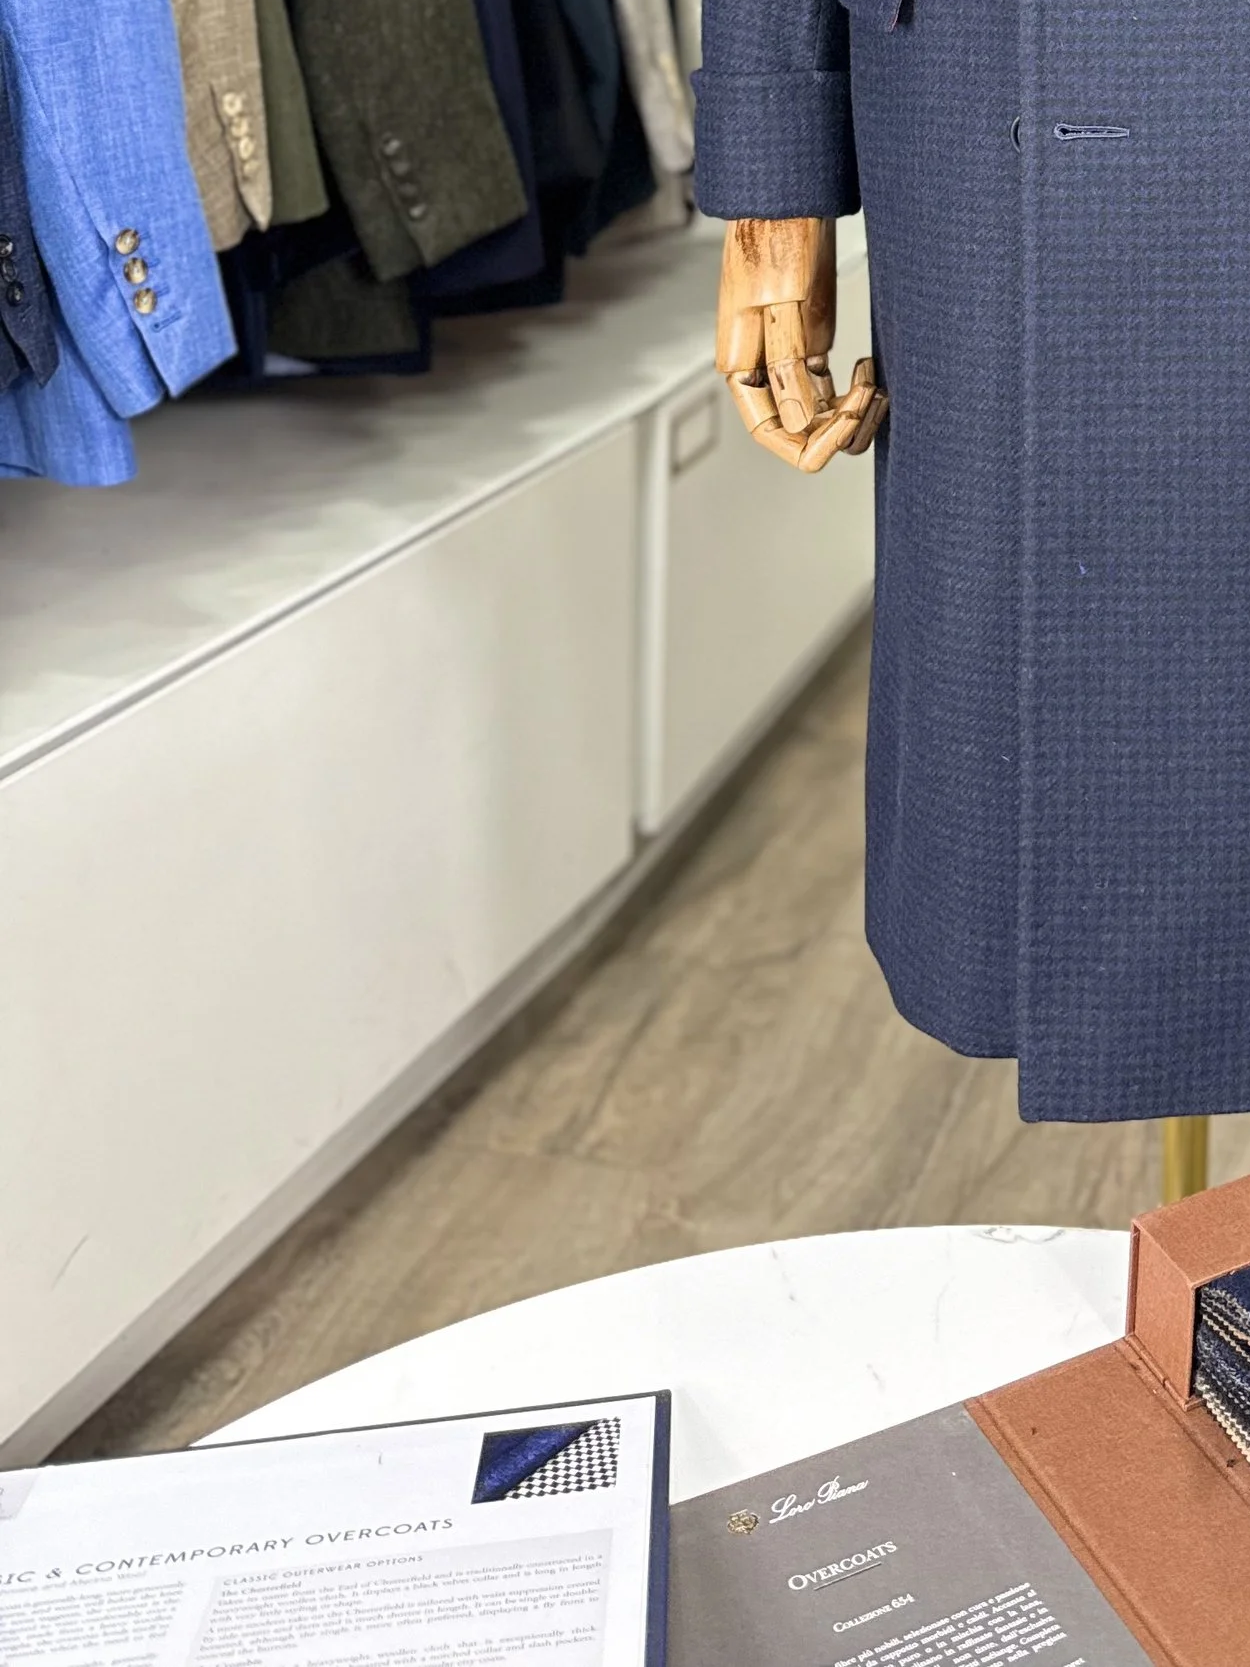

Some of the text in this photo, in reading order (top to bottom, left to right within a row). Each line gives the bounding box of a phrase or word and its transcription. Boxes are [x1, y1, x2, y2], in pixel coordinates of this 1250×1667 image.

[769, 1475, 869, 1524] Loro Piana
[45, 1567, 62, 1579] &
[75, 1537, 294, 1576] CONTEMPORARY
[305, 1517, 455, 1546] OVERCOATS
[223, 1554, 423, 1586] CLASSIC OUTERWEAR OPTIONS
